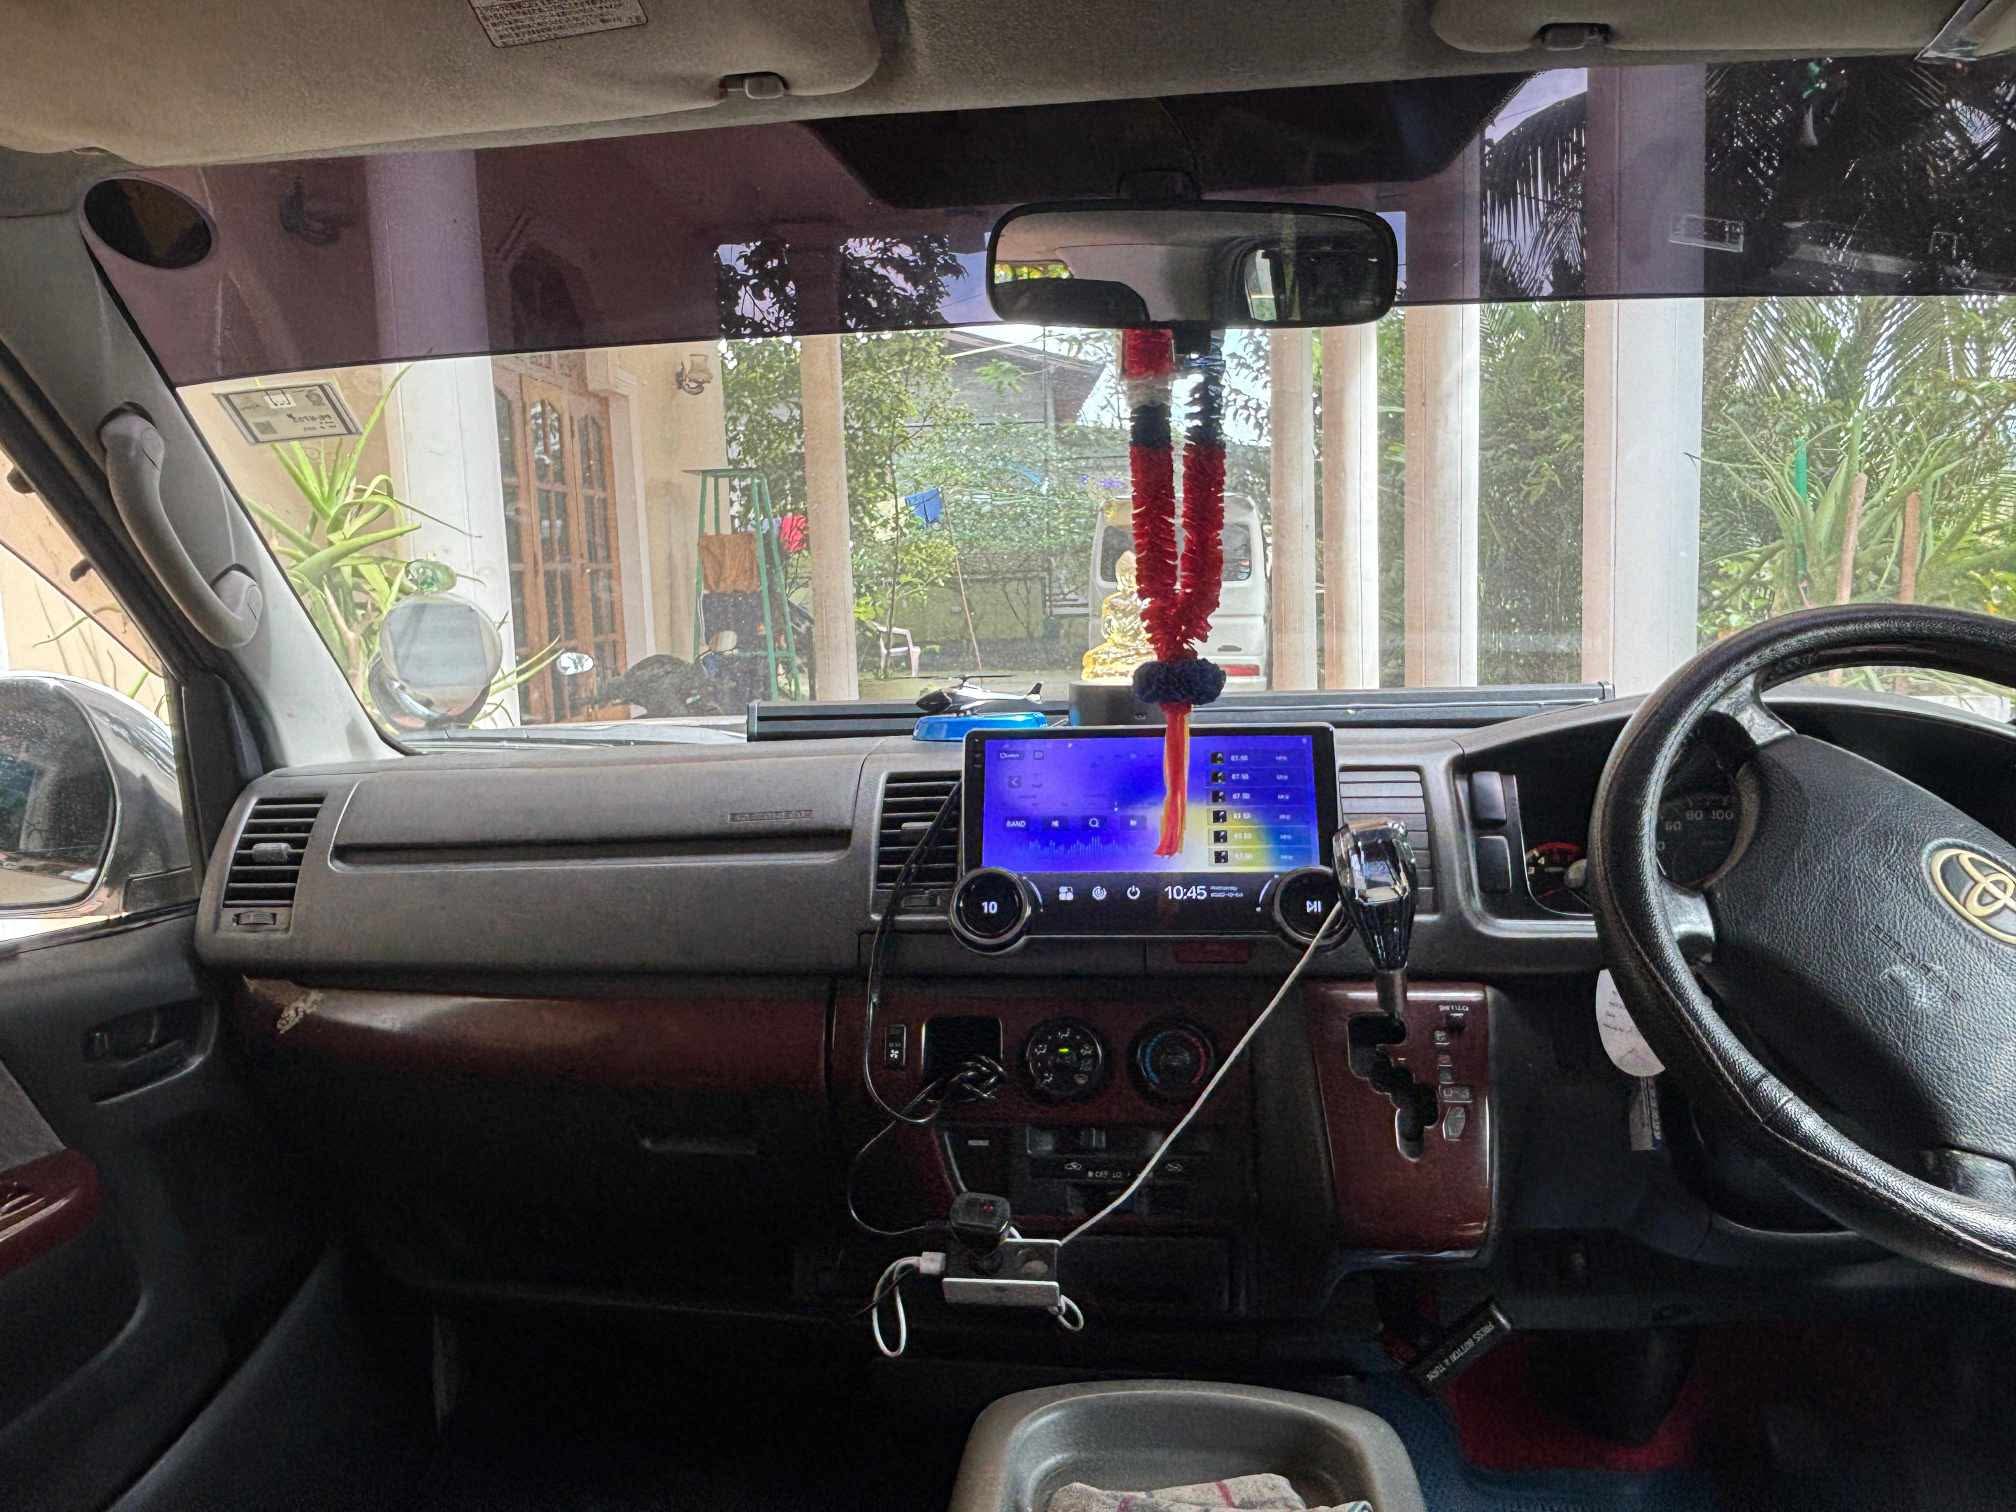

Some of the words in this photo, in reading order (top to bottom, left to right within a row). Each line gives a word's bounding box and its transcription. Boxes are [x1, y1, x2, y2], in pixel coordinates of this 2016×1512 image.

[1711, 809, 1734, 820] 100
[1164, 885, 1207, 900] 10:45
[981, 901, 998, 915] 10
